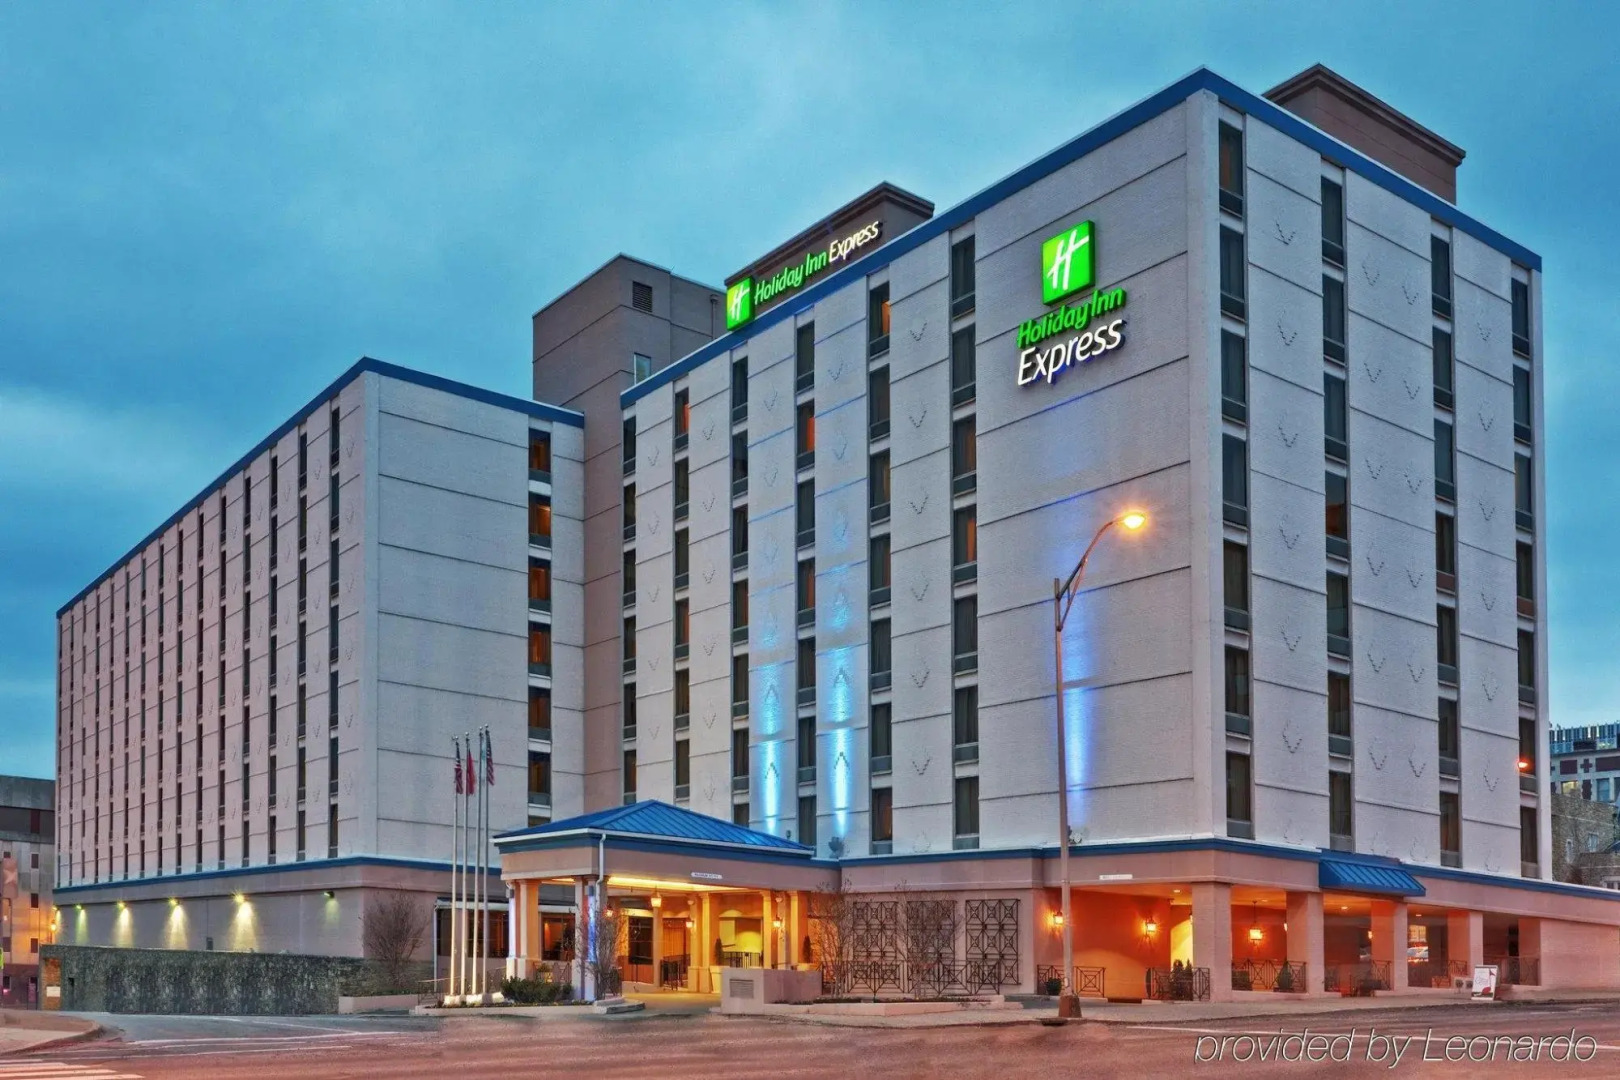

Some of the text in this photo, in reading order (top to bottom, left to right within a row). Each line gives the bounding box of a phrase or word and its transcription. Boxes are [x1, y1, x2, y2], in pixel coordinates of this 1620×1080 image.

[754, 220, 879, 305] Holiday Inn Express
[1017, 288, 1124, 348] Holiday Inn
[1017, 319, 1123, 386] Express
